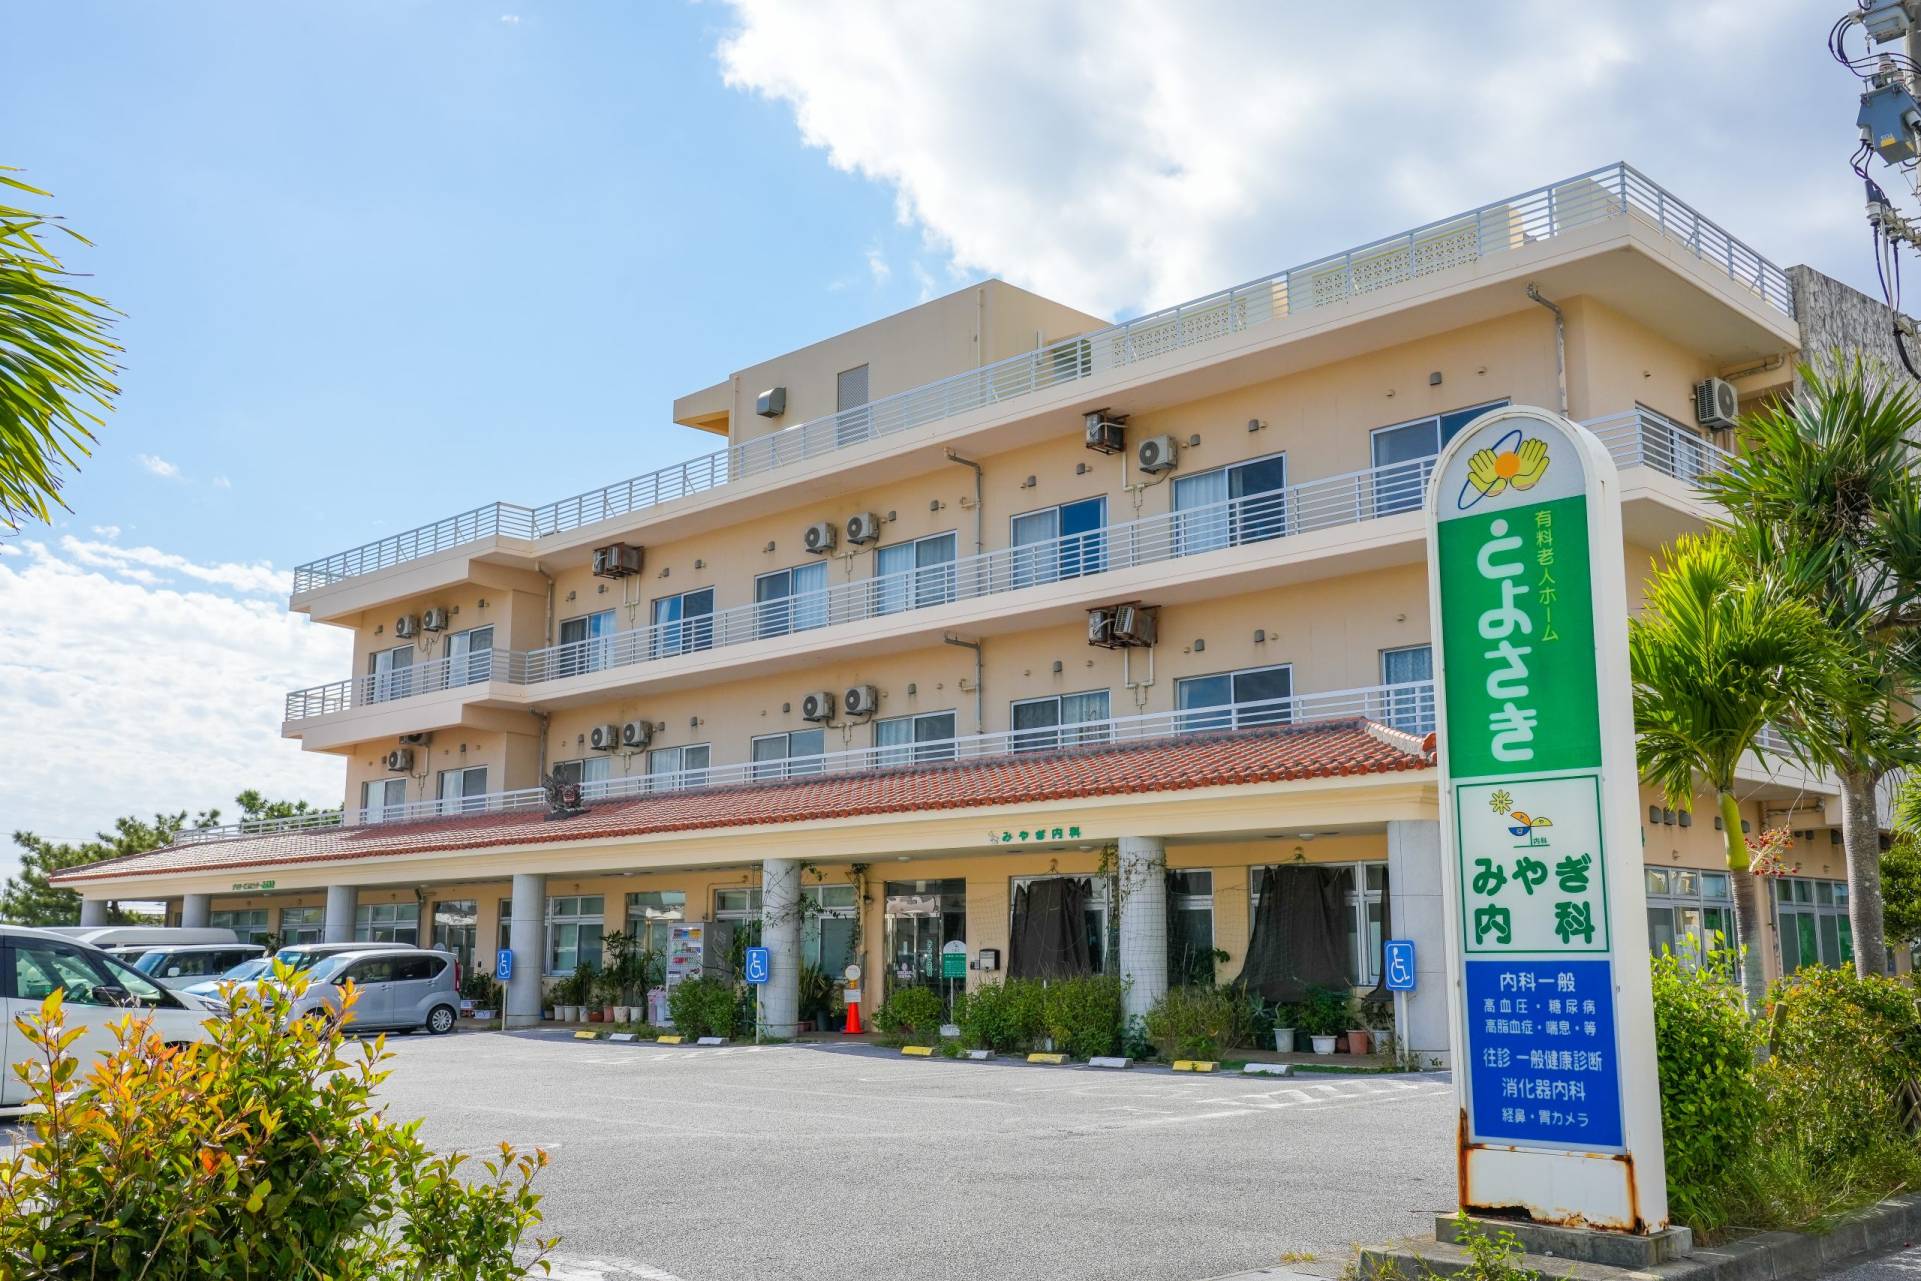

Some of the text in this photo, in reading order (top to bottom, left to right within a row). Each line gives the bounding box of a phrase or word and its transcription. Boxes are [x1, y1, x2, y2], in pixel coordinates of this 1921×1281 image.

[1534, 510, 1559, 642] 有料老人ホーム
[1476, 518, 1538, 763] とよさき
[1001, 826, 1081, 842] みやぎ内科
[1472, 852, 1592, 896] みやぎ
[1474, 900, 1596, 945] 内科
[1499, 971, 1576, 992] 内科一般
[1483, 998, 1597, 1015] 高血圧・糖尿病
[1484, 1019, 1597, 1037] 高脂血症・喘息・等
[1482, 1047, 1603, 1072] 往診 一般健康診断
[1501, 1077, 1586, 1102] 消化器内科
[1501, 1107, 1590, 1127] 経鼻・胃カメラ
